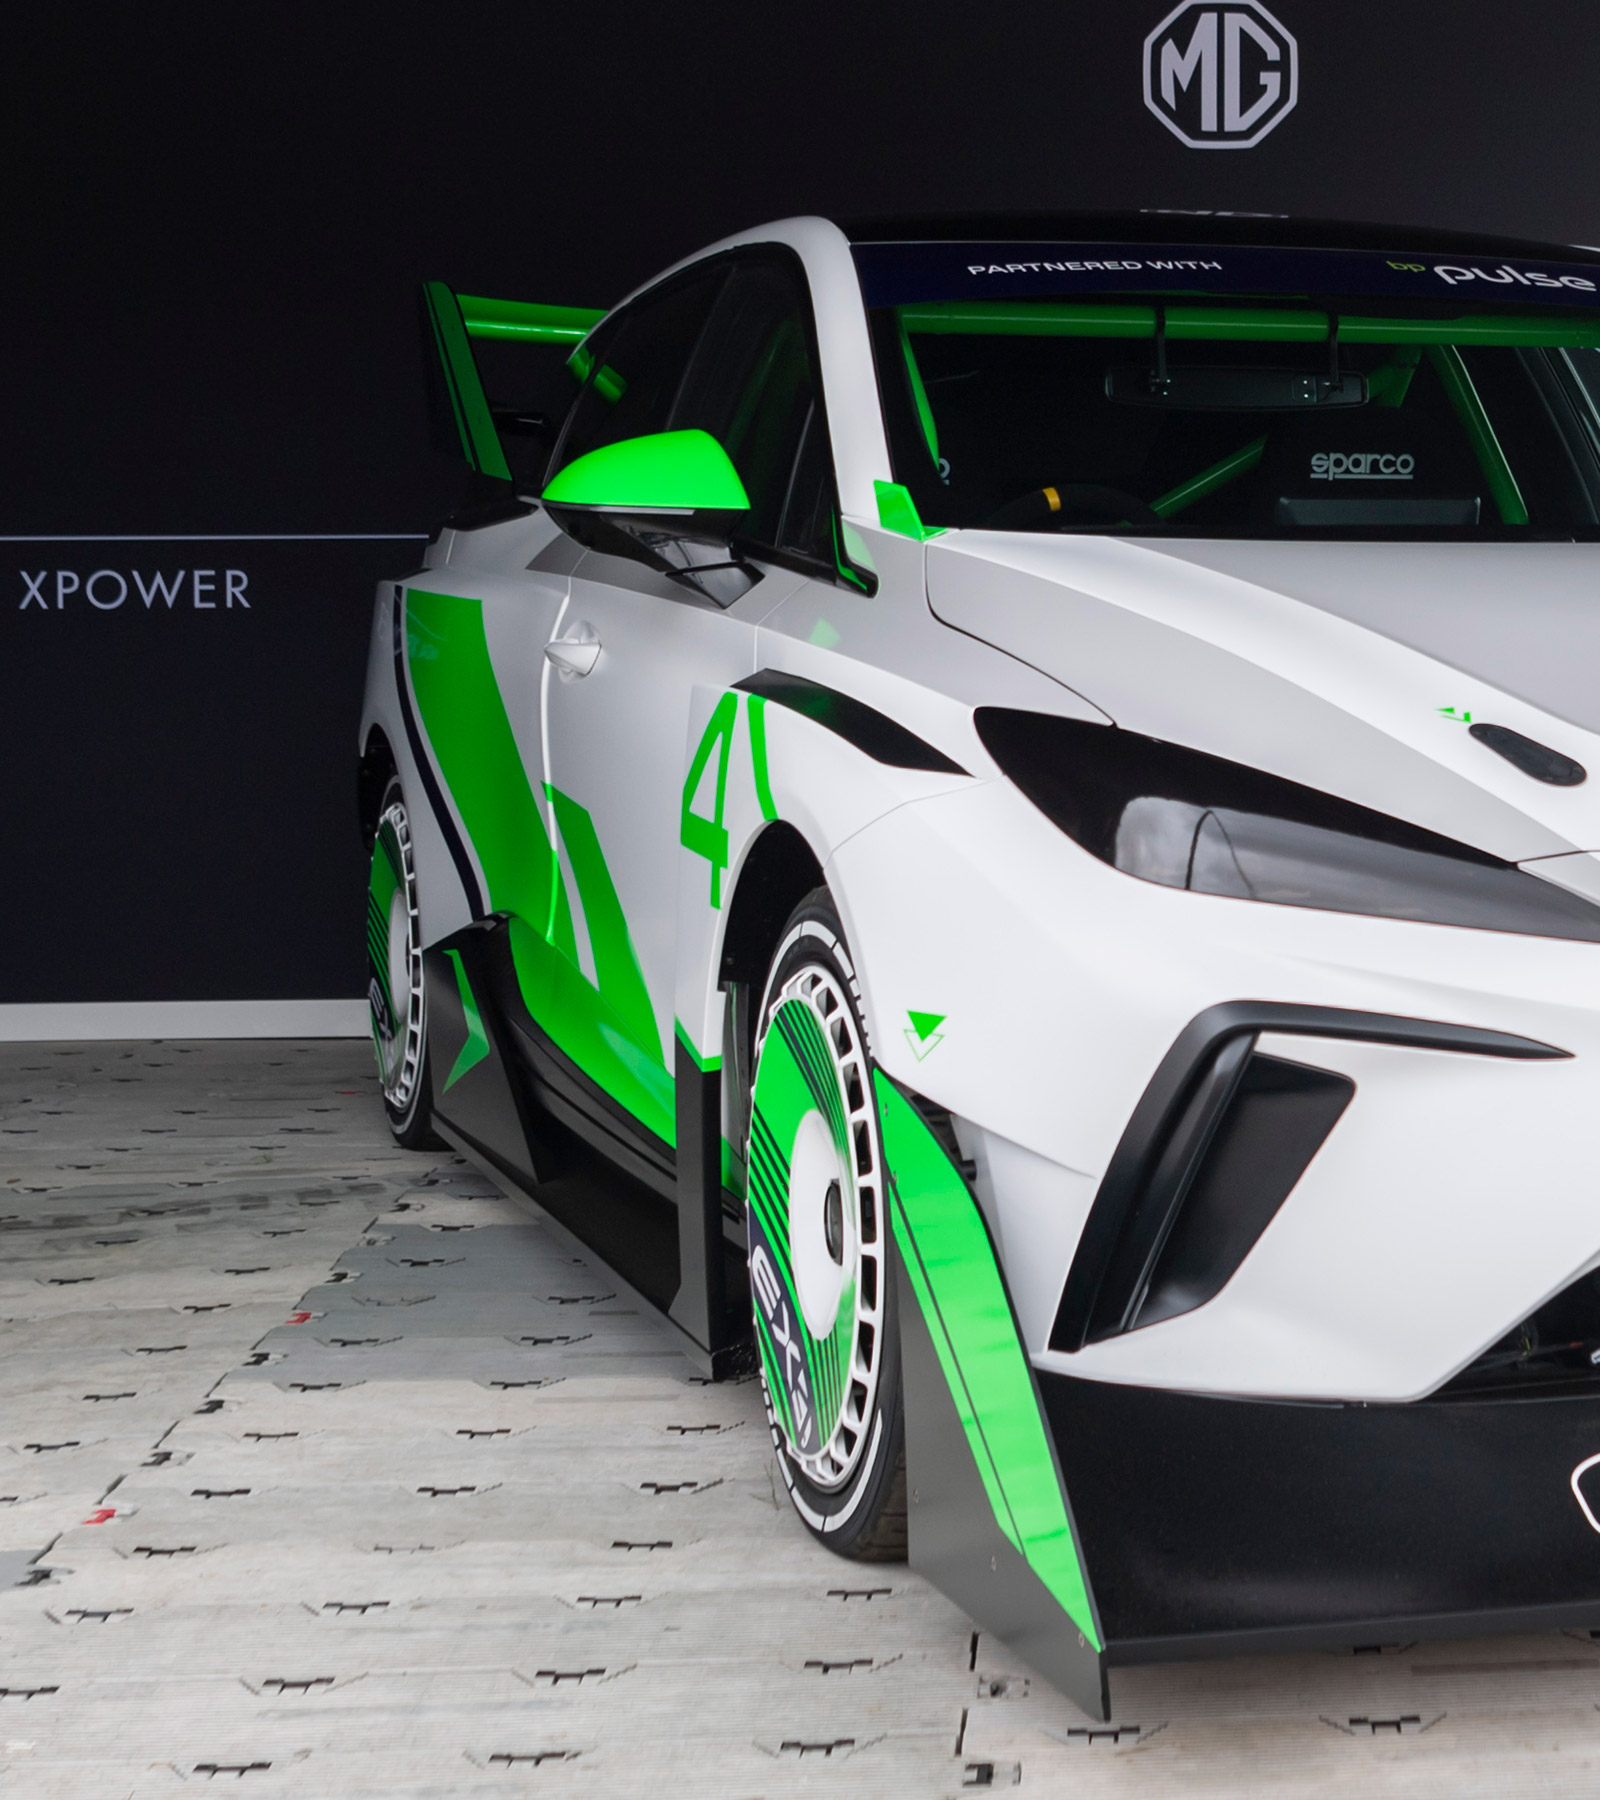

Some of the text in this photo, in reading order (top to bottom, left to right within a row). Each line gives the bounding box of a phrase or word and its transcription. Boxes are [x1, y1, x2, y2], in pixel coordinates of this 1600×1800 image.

[1160, 12, 1282, 133] MG
[966, 260, 1597, 292] PARTNERED WITH bp pulse
[1310, 452, 1415, 481] sparco
[18, 569, 251, 610] XPOWER
